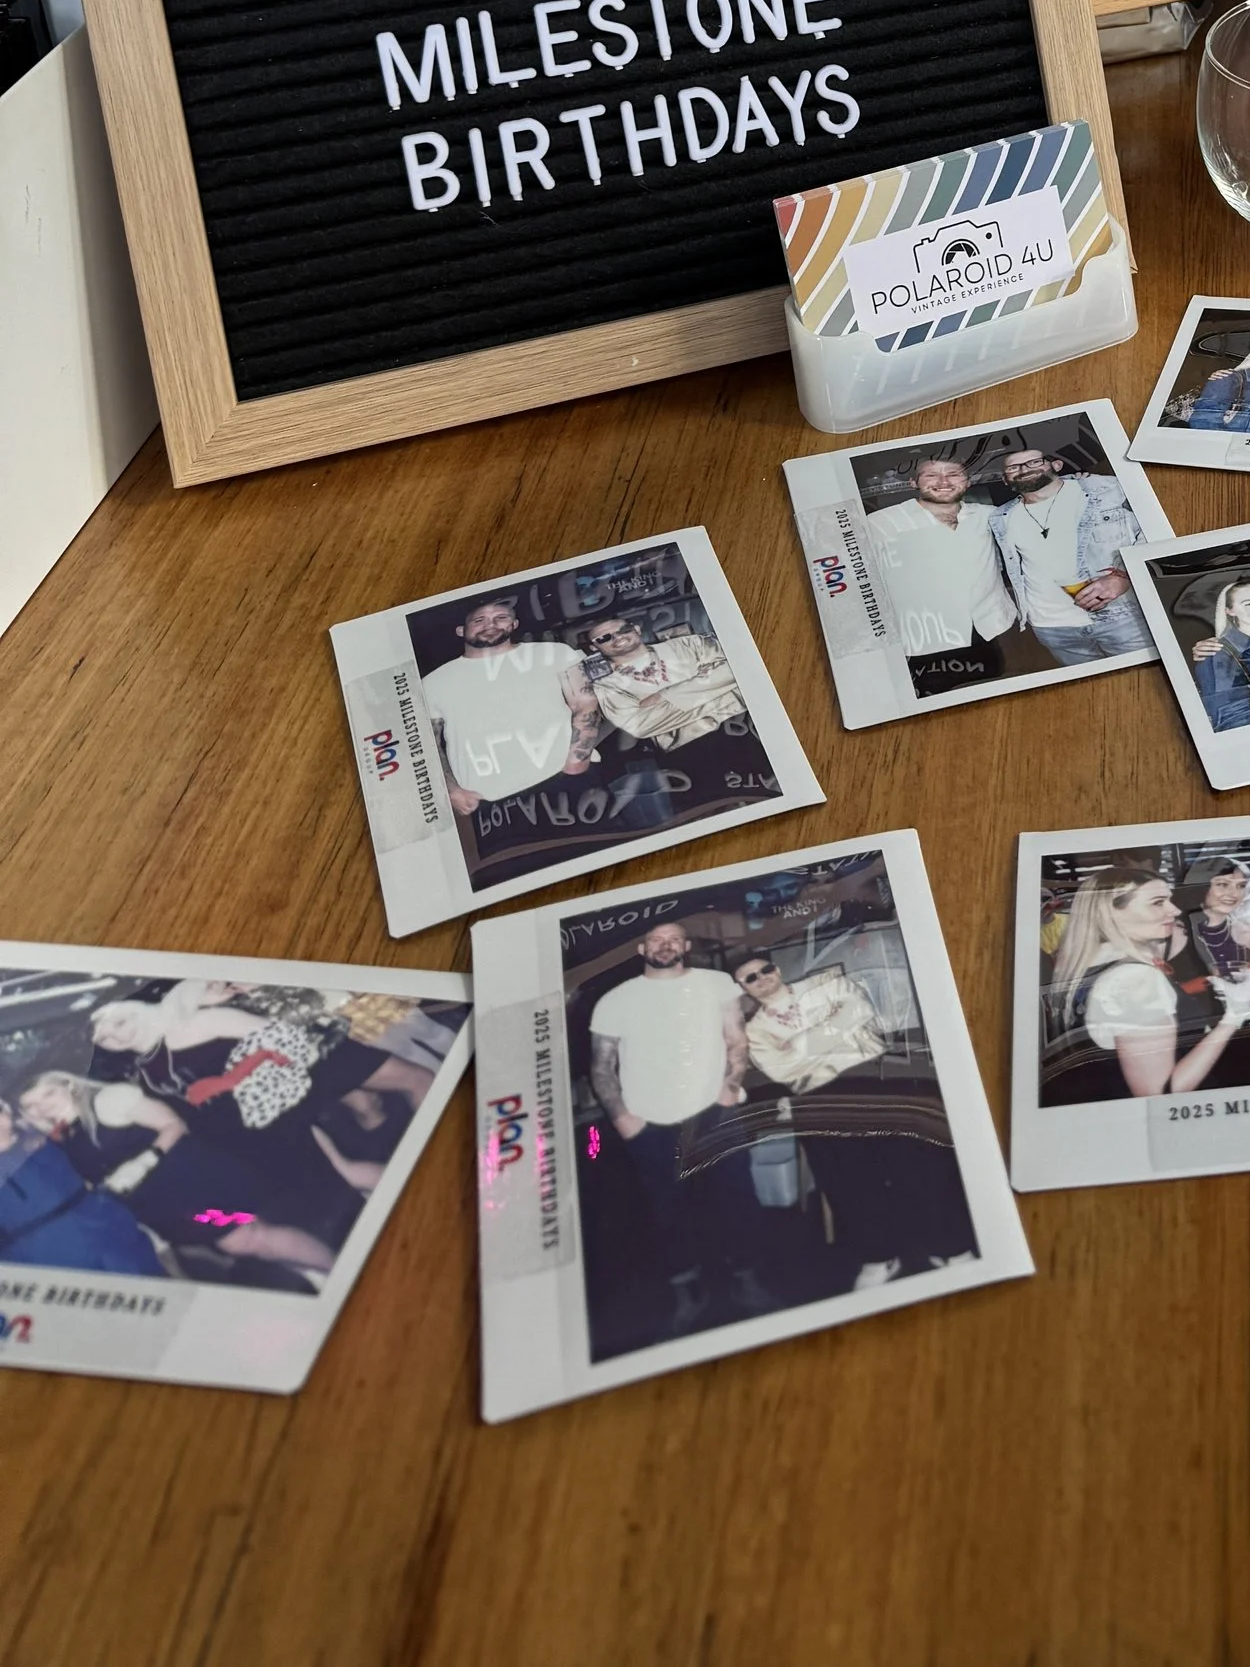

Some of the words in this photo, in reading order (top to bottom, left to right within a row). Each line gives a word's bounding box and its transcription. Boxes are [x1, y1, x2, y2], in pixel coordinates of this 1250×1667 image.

[401, 63, 861, 212] BIRTHDAYS
[871, 253, 1013, 315] POLAROID
[1021, 238, 1054, 268] 4U
[911, 295, 957, 314] VINTAGE
[961, 273, 1024, 300] EXPERIENCE
[835, 509, 850, 528] 2025
[842, 530, 868, 581] MILESTONE
[859, 582, 886, 638] BIRTHDAYS
[394, 672, 410, 696] 2025
[398, 697, 424, 758] MILESTONE
[412, 758, 438, 824] BIRTHDAYS
[534, 1008, 550, 1044] 2025
[1169, 1103, 1215, 1122] 2025
